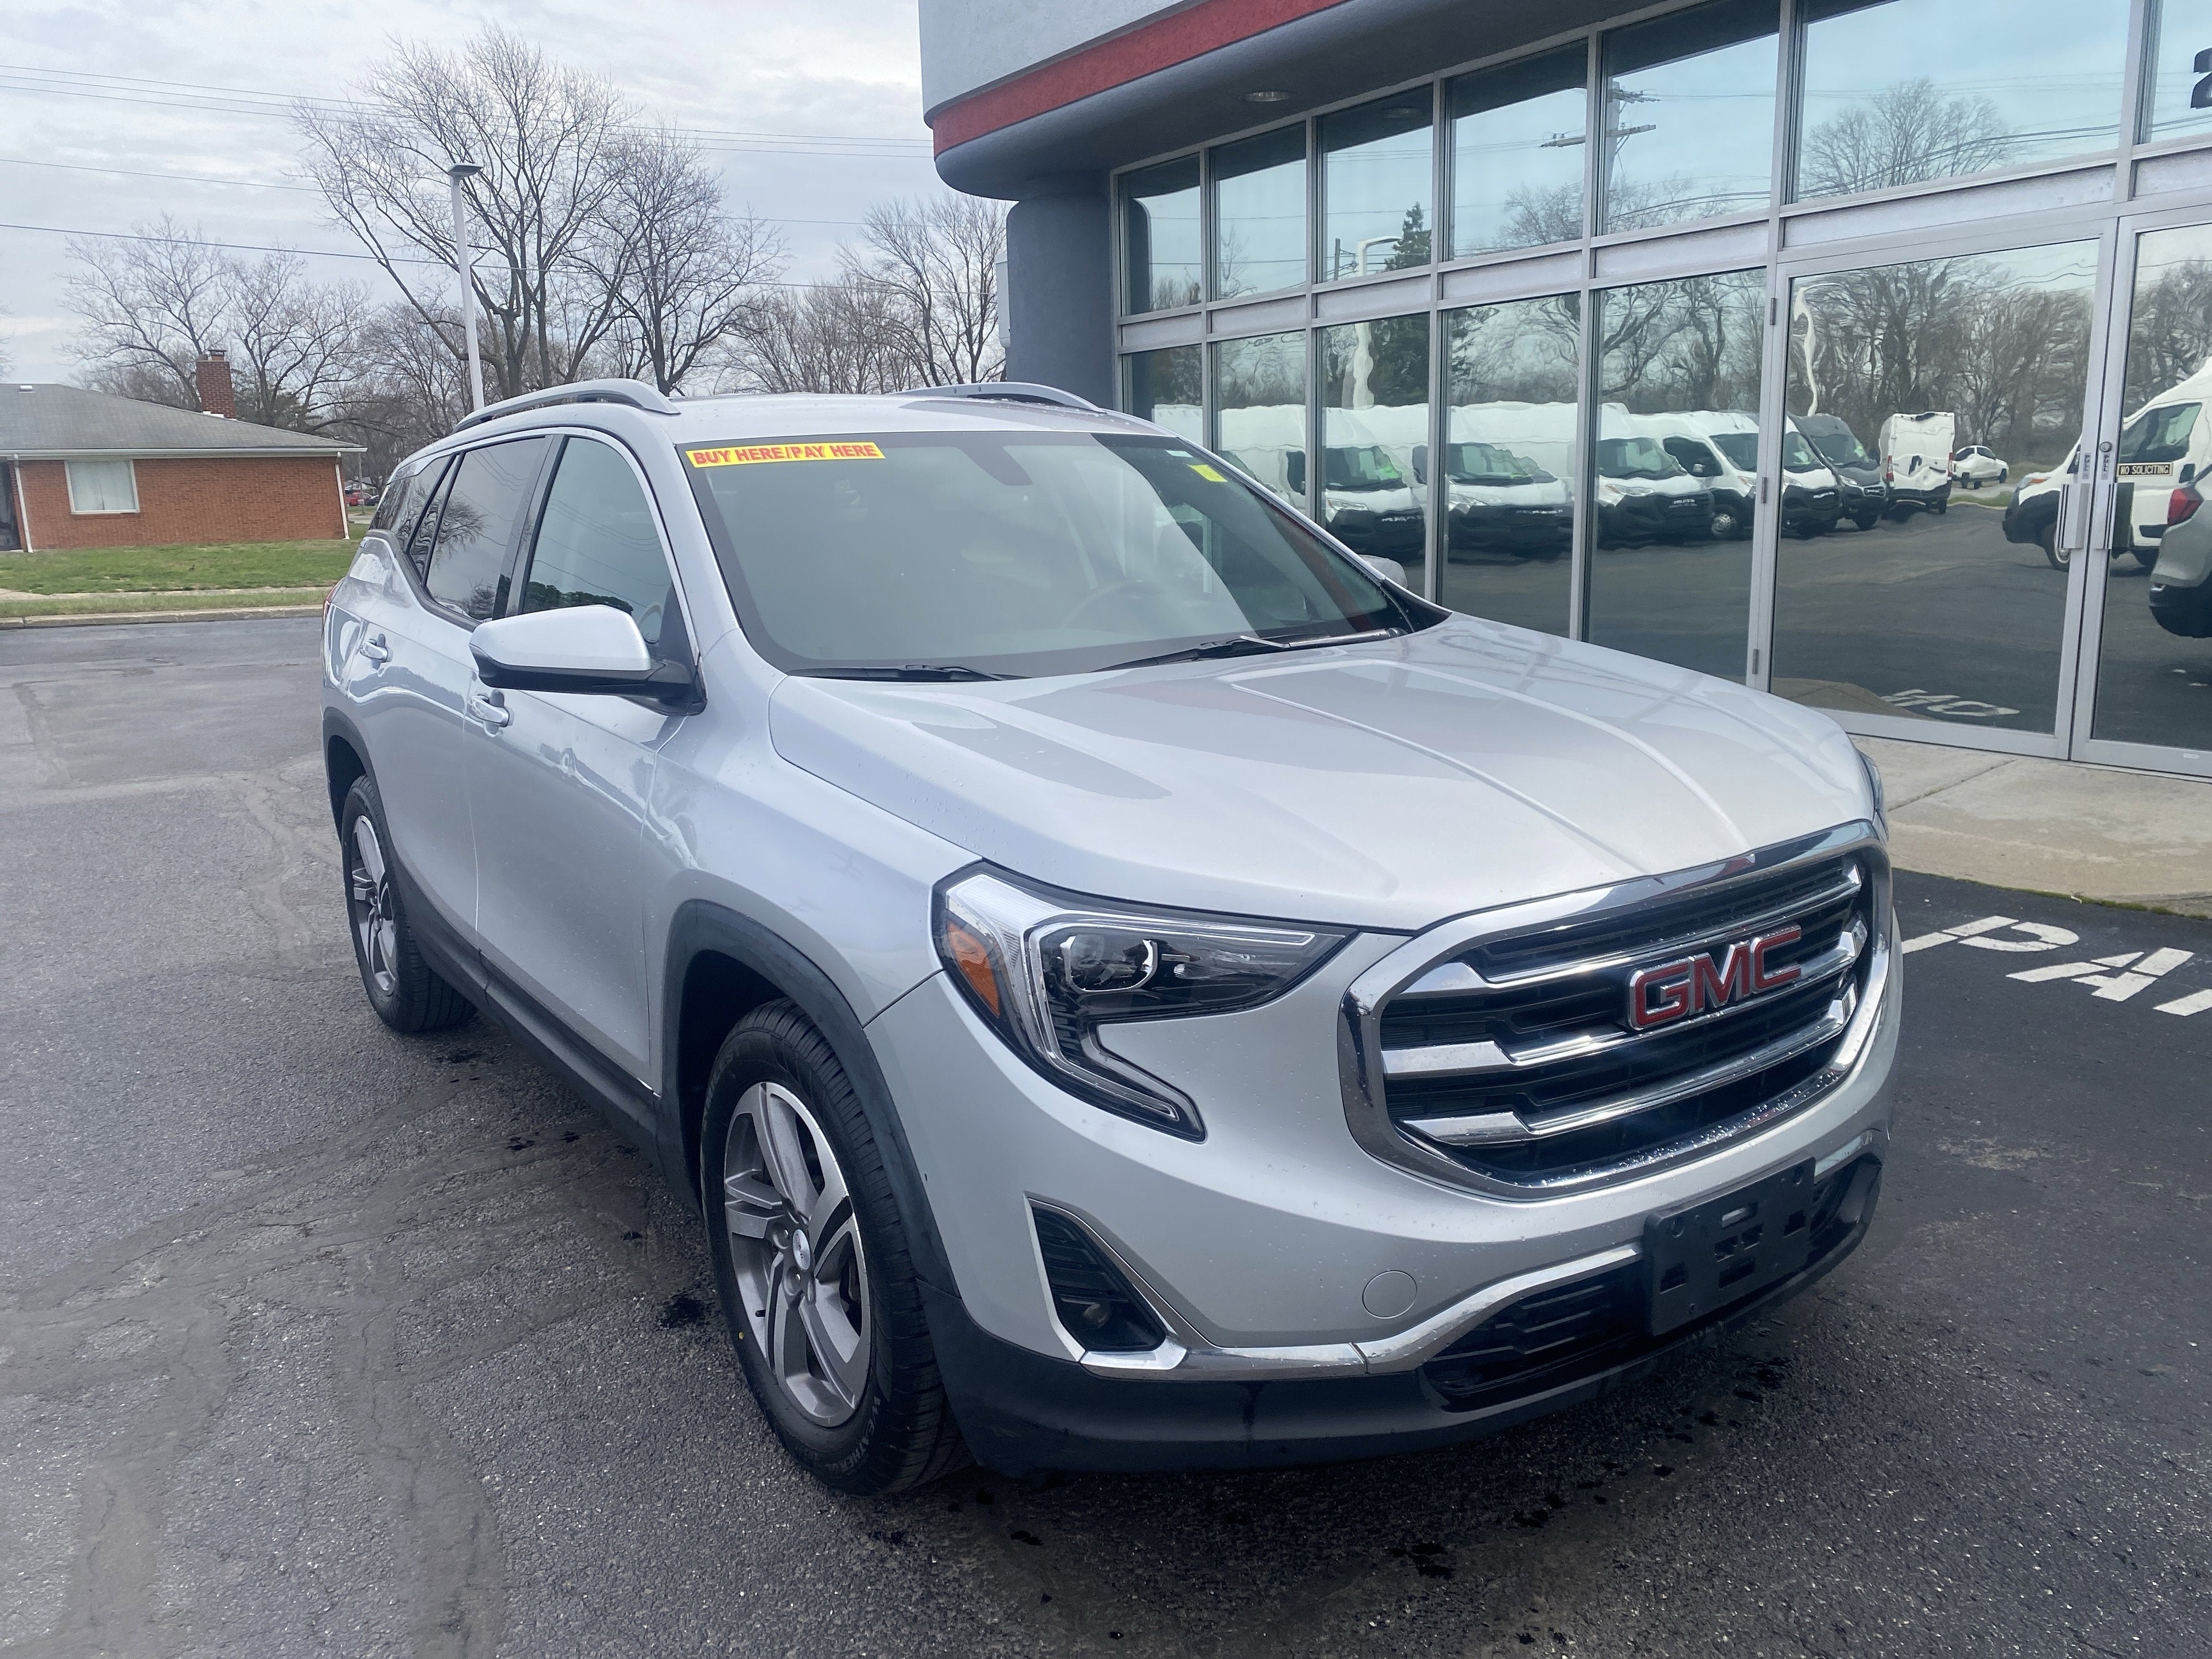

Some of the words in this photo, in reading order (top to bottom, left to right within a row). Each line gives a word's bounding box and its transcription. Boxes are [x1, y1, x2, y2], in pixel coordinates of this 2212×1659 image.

[693, 450, 731, 465] BUY
[734, 445, 826, 461] HERE/PAY
[829, 445, 879, 458] HERE
[2120, 466, 2130, 475] NO
[2131, 465, 2169, 474] SOLICITING
[1628, 923, 1802, 1031] GMC
